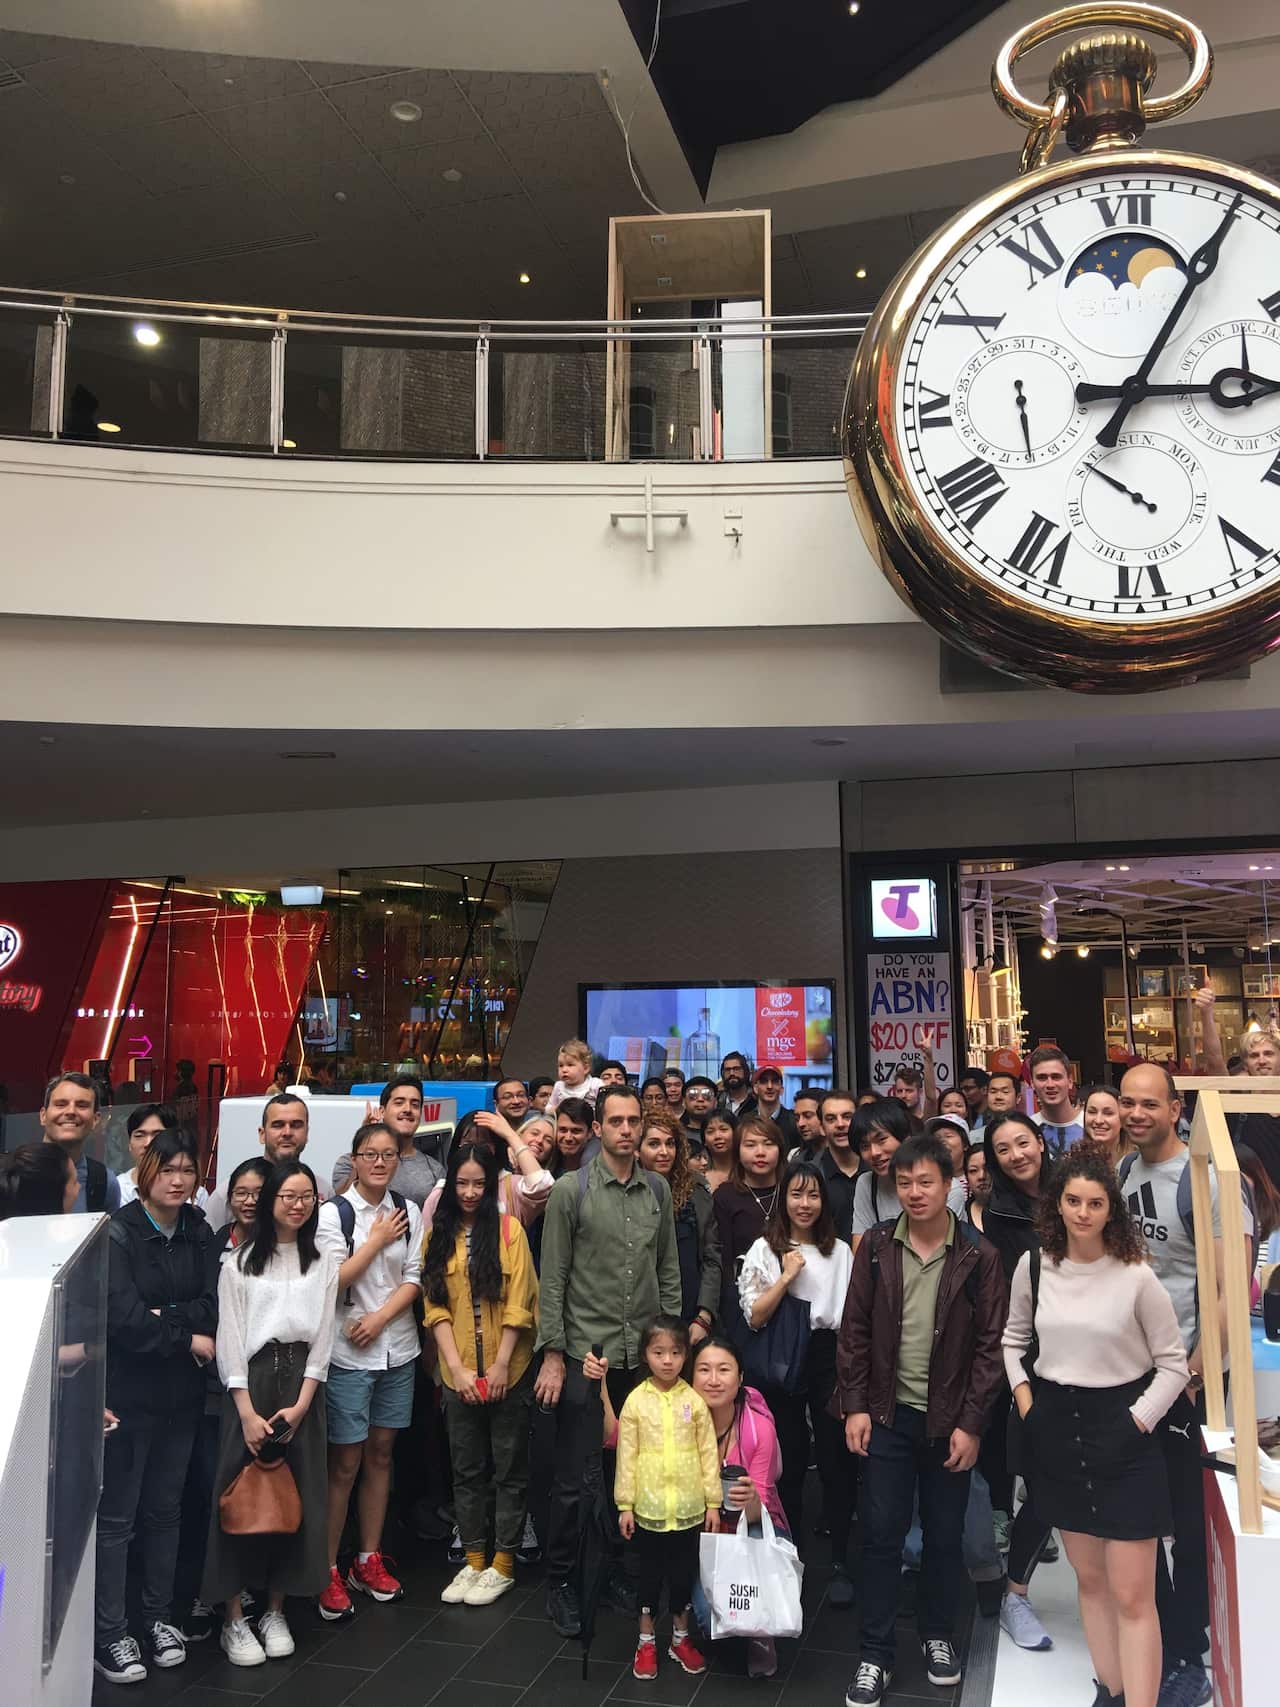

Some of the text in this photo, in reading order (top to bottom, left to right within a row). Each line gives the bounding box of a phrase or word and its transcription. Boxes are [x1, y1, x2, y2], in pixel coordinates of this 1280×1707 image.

[996, 217, 1065, 291] XI
[934, 288, 1007, 344] X
[1199, 328, 1225, 349] NOV.
[987, 343, 1004, 358] 29
[968, 357, 983, 374] 27
[957, 378, 970, 393] 25
[976, 442, 990, 456] 19
[1118, 434, 1156, 447] SUN.
[998, 453, 1011, 464] 17
[1168, 443, 1200, 477] MON.
[1188, 492, 1208, 525] TUE.
[1091, 539, 1128, 562] THU.
[1144, 540, 1183, 562] WED.
[1217, 514, 1275, 577] V
[889, 885, 921, 919] T
[883, 954, 935, 966] DO YOU
[875, 967, 936, 979] HAVE AN
[871, 981, 949, 1017] ABN?
[767, 1037, 796, 1052] mgc
[870, 1021, 908, 1053] $20
[900, 1052, 921, 1061] OUR
[729, 1583, 758, 1598] SUSHI
[729, 1597, 750, 1610] HUB
